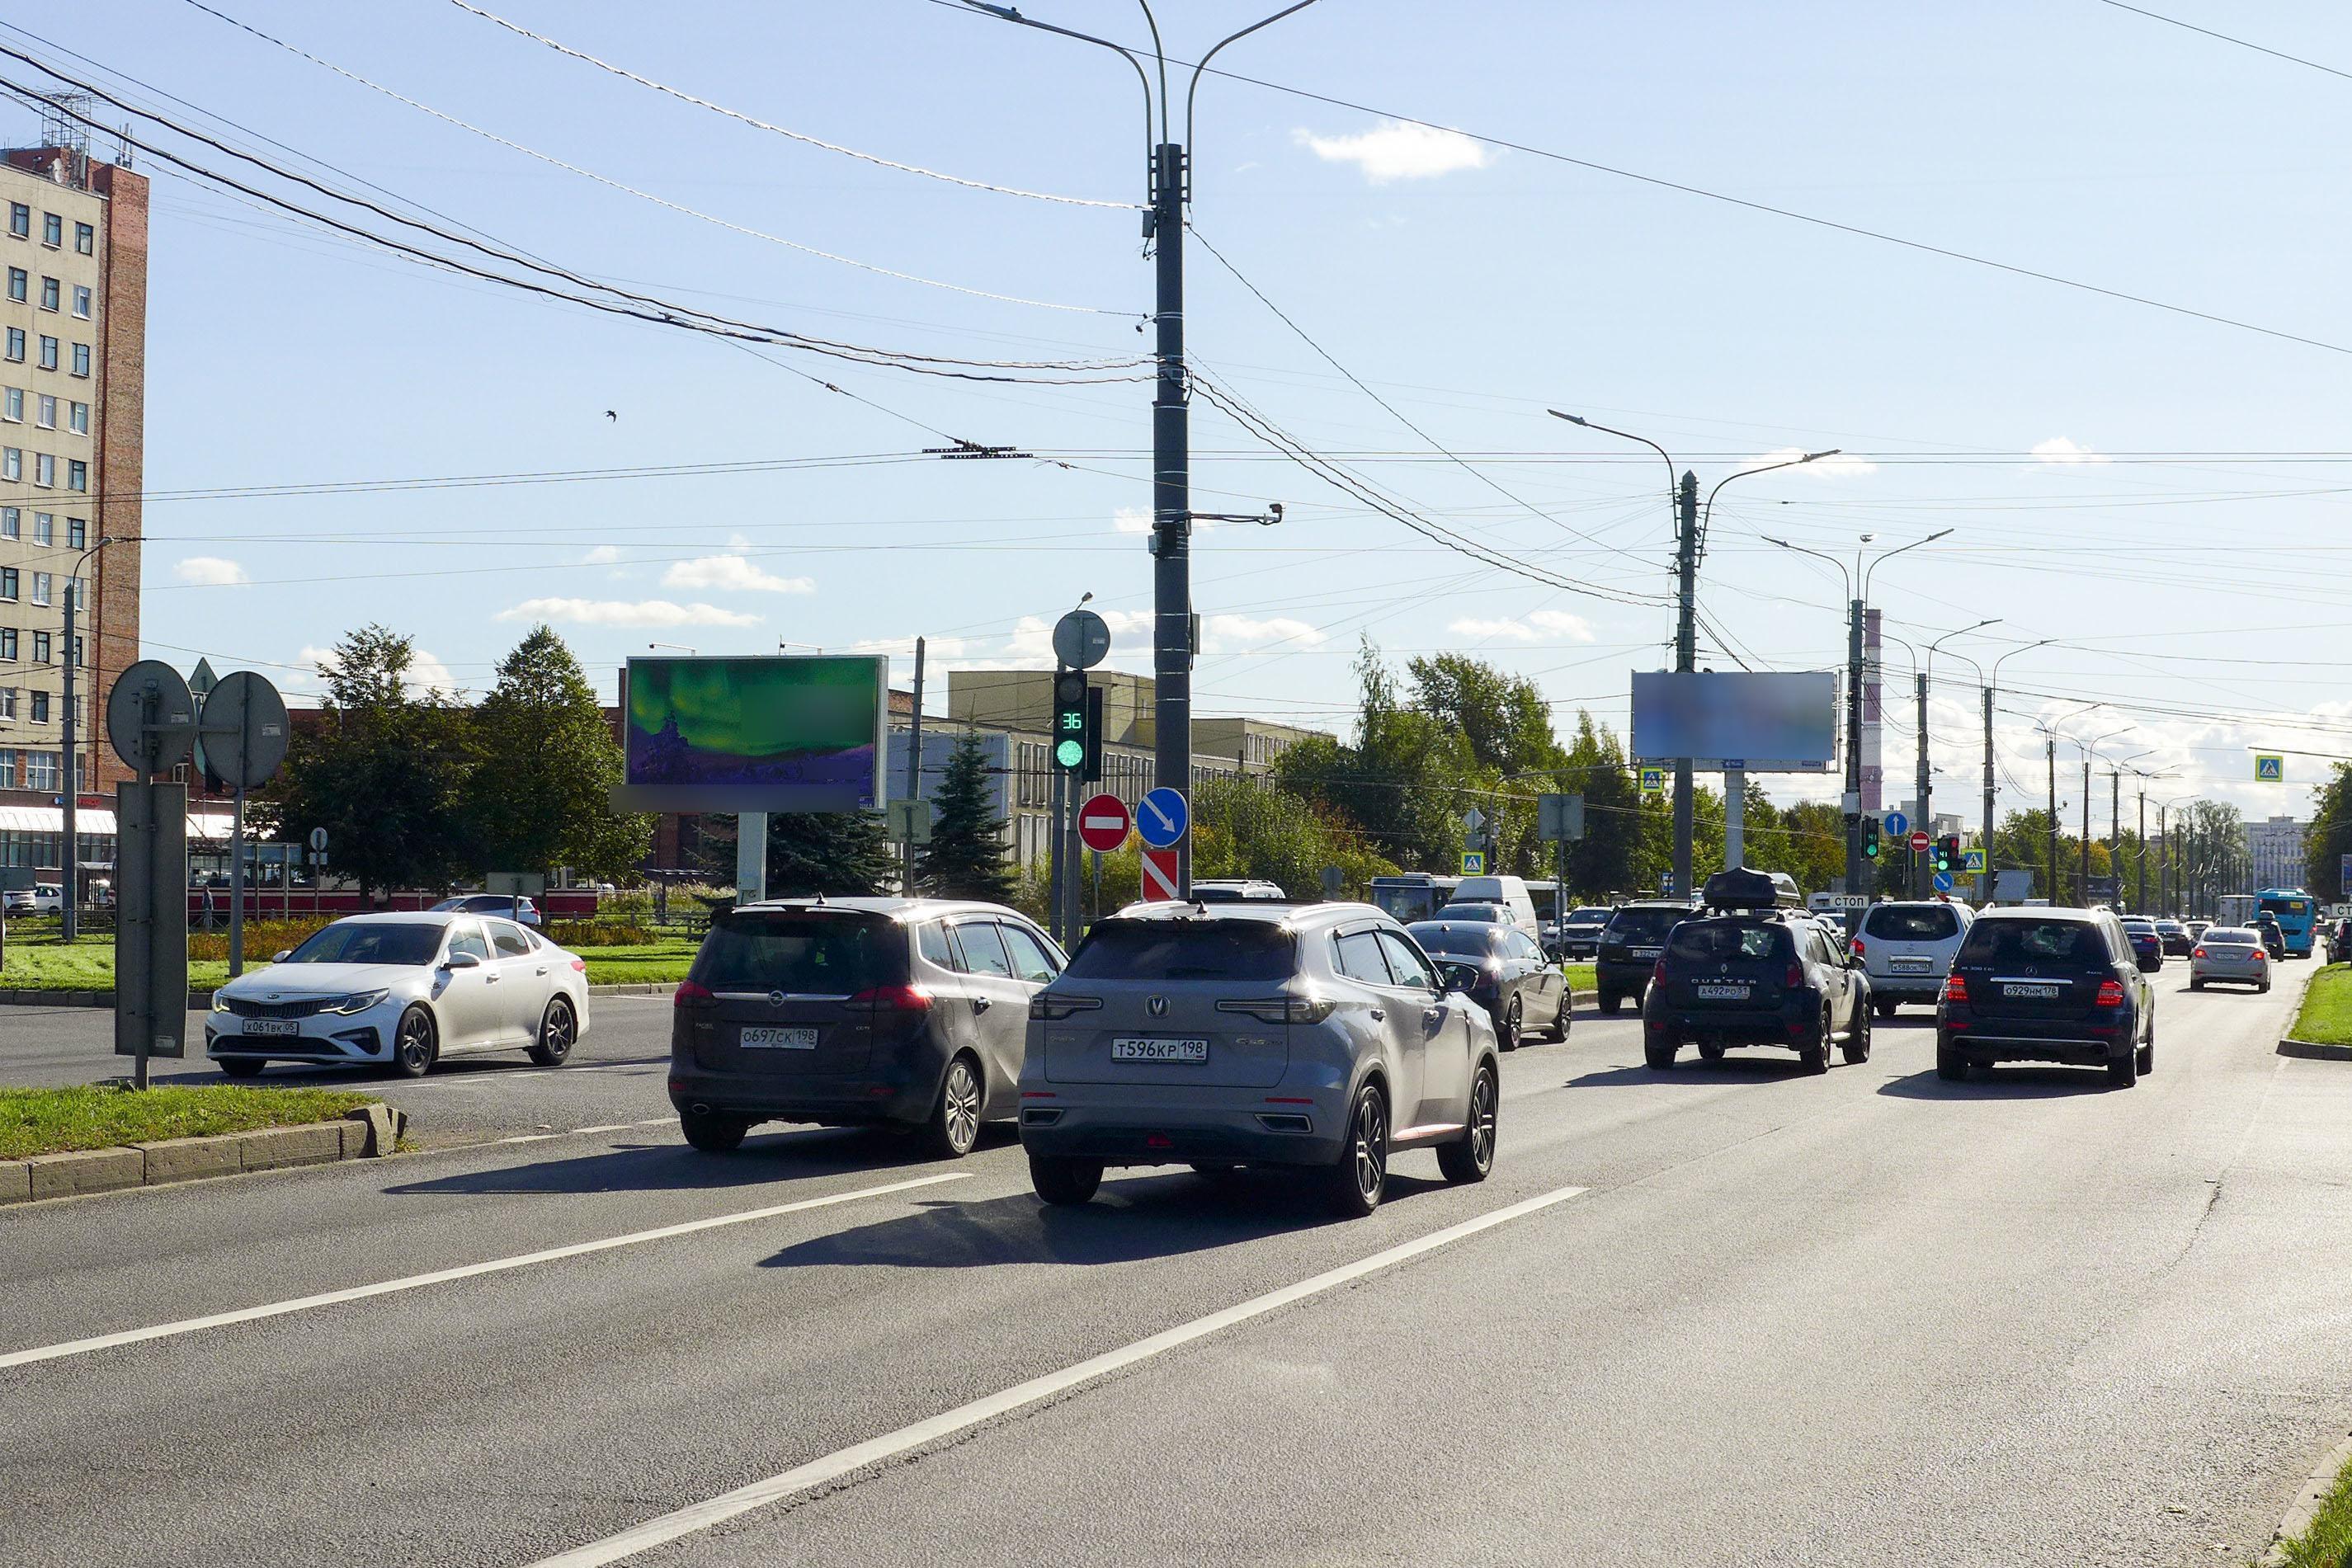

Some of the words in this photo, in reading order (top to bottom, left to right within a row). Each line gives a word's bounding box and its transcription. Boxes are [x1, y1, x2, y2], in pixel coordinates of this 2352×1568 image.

[1063, 713, 1082, 729] 36
[1835, 897, 1864, 906] СТОП
[743, 1029, 792, 1043] О697СК
[796, 1031, 814, 1040] 198
[1118, 1041, 1177, 1057] Т596КР
[1181, 1041, 1203, 1053] 198
